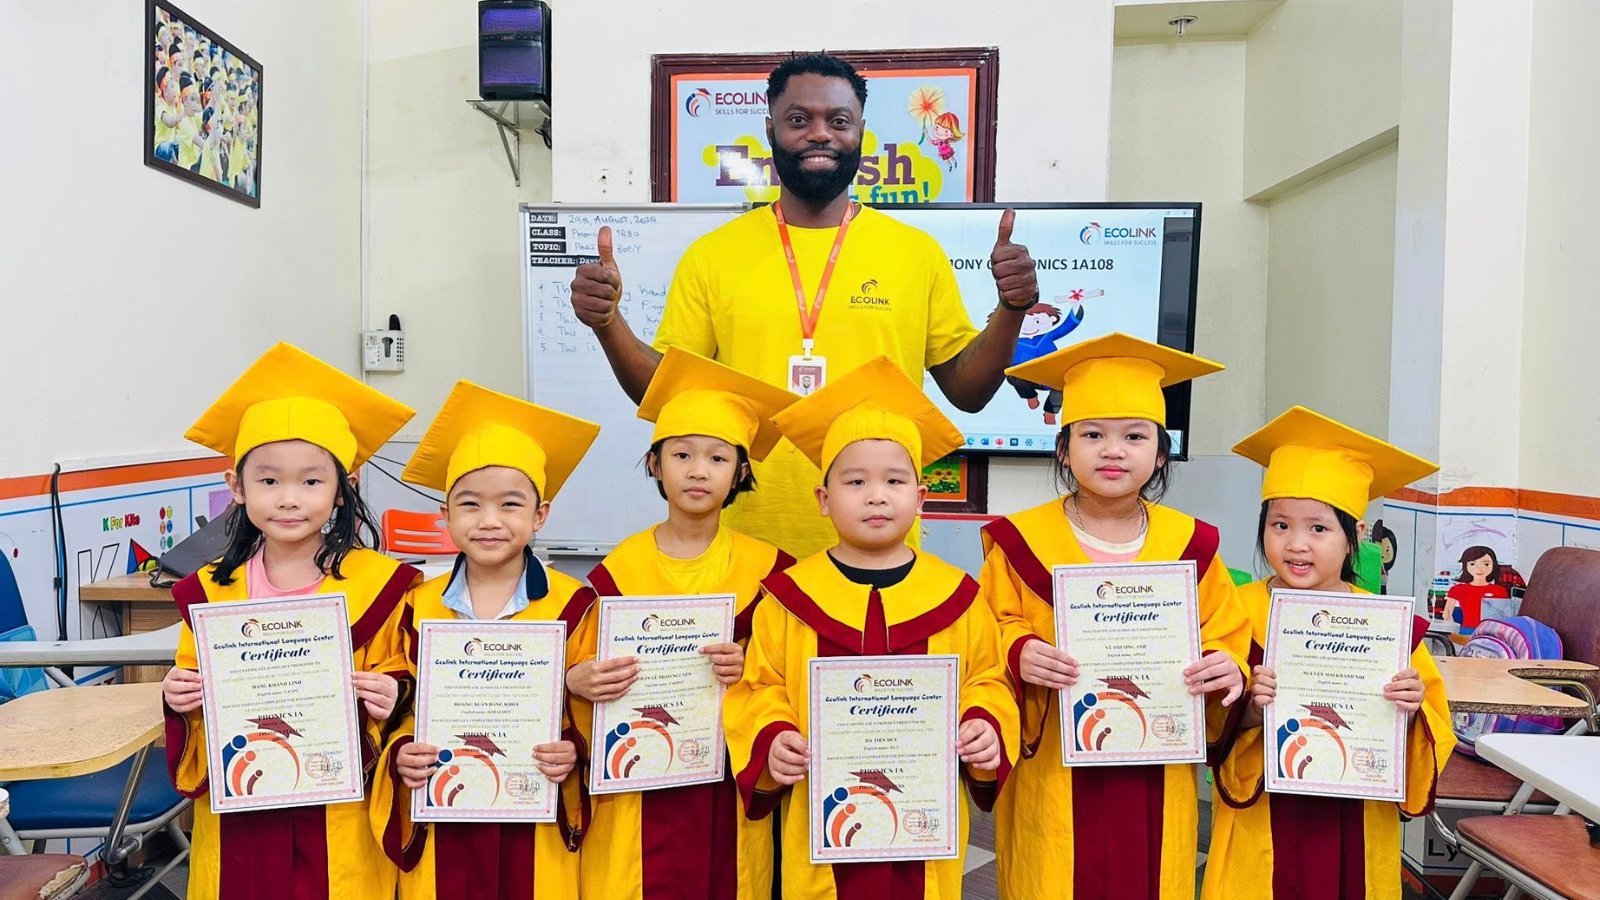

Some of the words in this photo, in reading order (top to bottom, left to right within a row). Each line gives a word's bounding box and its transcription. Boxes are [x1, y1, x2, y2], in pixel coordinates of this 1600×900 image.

[715, 92, 769, 104] ECOLIN
[716, 143, 916, 186] Ensh
[1104, 227, 1156, 238] ECOLINK
[1072, 259, 1114, 270] 1A108
[552, 282, 570, 294] Th
[553, 296, 571, 308] Thi
[850, 296, 890, 305] ECOLINK
[557, 326, 576, 337] This
[557, 342, 577, 352] This
[587, 343, 596, 351] is
[103, 518, 109, 531] K
[110, 516, 124, 530] For
[125, 513, 140, 528] Kite
[1115, 585, 1153, 594] ECOLINK
[1132, 601, 1161, 609] Language
[660, 618, 696, 626] ECOLINK
[1094, 612, 1159, 624] Certificate
[1330, 616, 1368, 625] ECOLINK
[261, 620, 303, 631] ECOLINK
[238, 638, 280, 648] International
[281, 636, 312, 645] Language
[1345, 633, 1374, 641] Language
[636, 643, 698, 656] Certificate
[1305, 639, 1370, 654] Certificate
[240, 647, 310, 662] Certificate
[458, 669, 525, 681] Certificate
[874, 678, 913, 687] ECOLINK
[849, 705, 917, 717] Certificate
